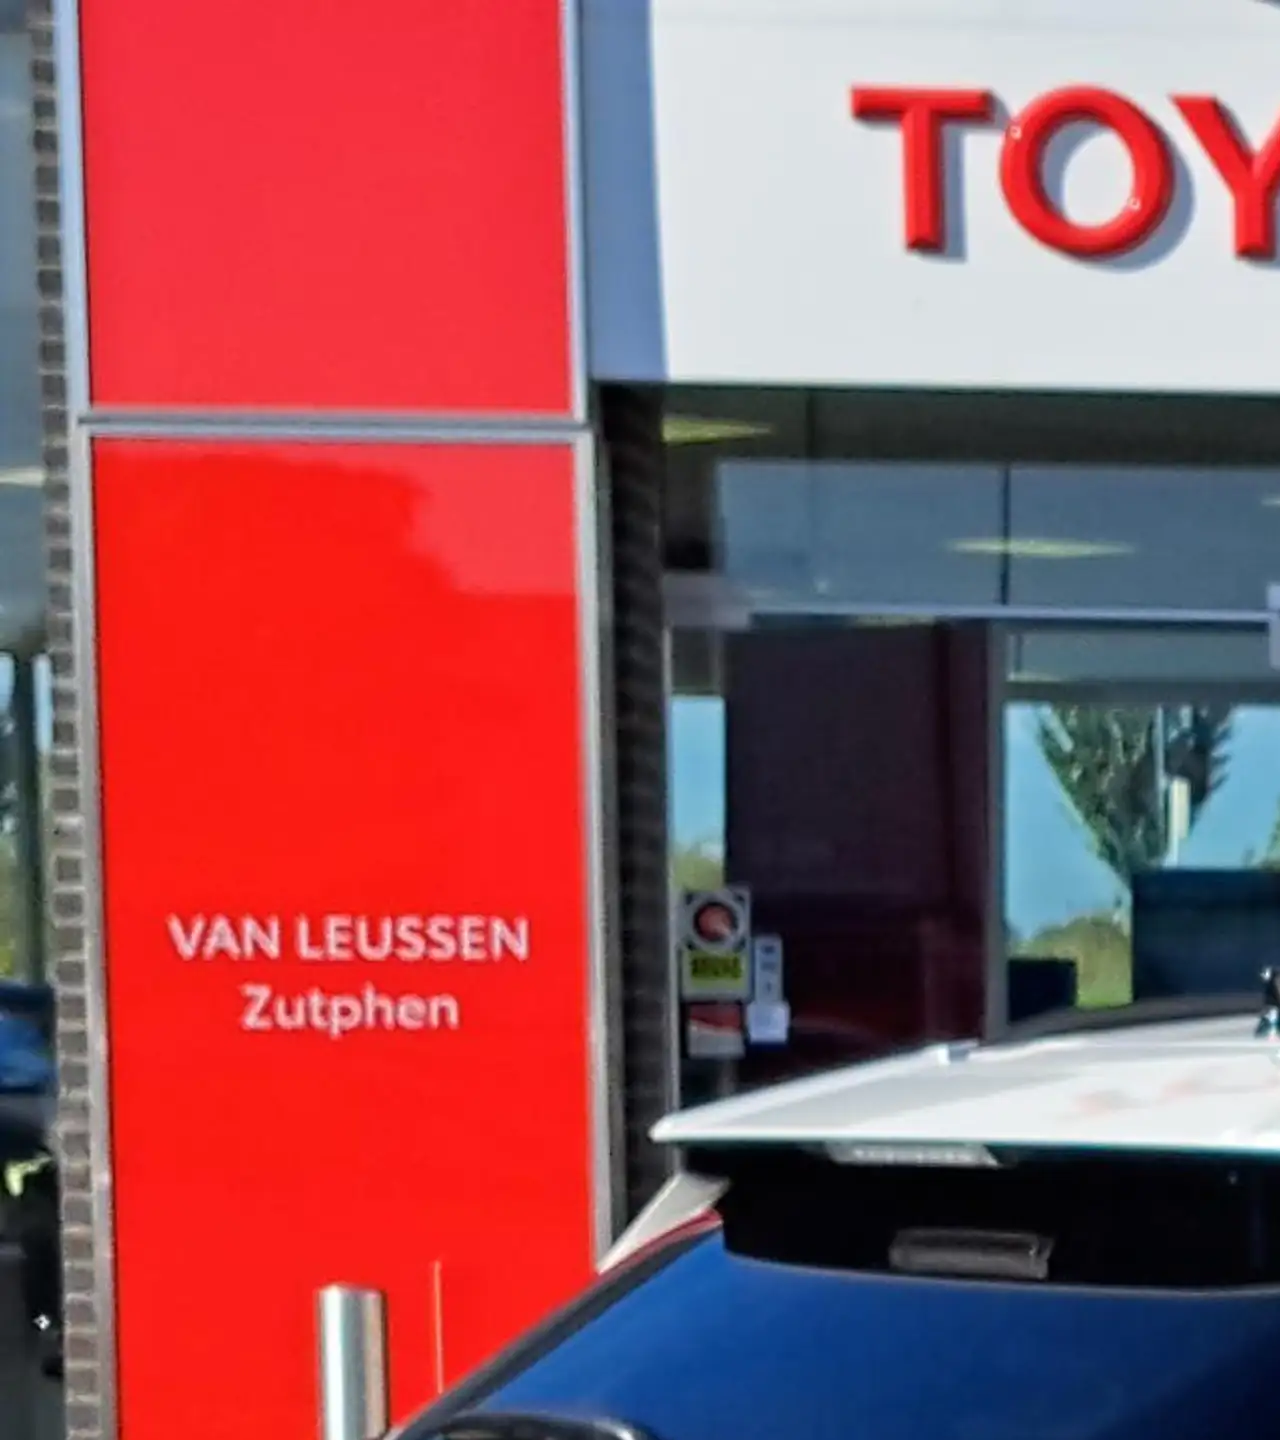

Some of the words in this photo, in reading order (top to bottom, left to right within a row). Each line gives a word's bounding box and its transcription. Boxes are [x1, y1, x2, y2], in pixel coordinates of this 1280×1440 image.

[166, 913, 280, 961] VAN
[296, 913, 530, 962] LEUSSEN
[240, 981, 460, 1041] Zutphen
